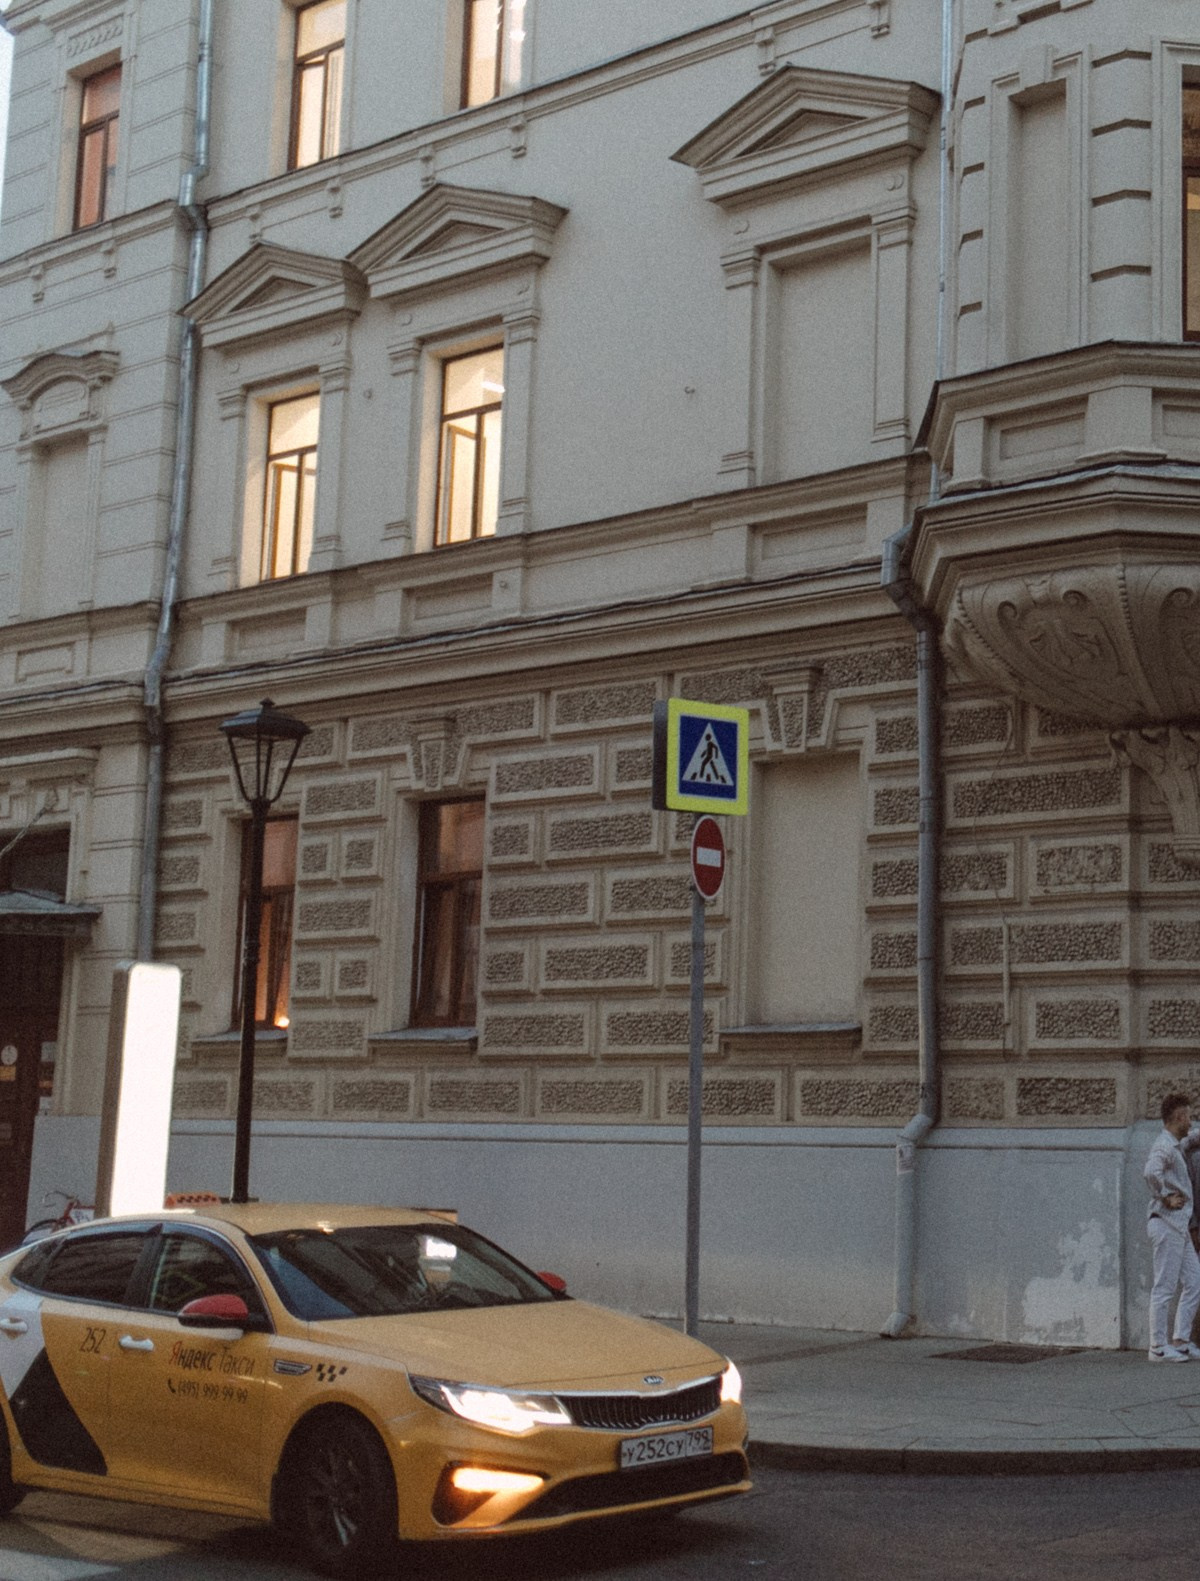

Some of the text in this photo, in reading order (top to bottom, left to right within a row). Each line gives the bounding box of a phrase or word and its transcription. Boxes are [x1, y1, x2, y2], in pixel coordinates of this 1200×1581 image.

[80, 1327, 107, 1354] 252
[168, 1340, 256, 1375] Яндекс Такси
